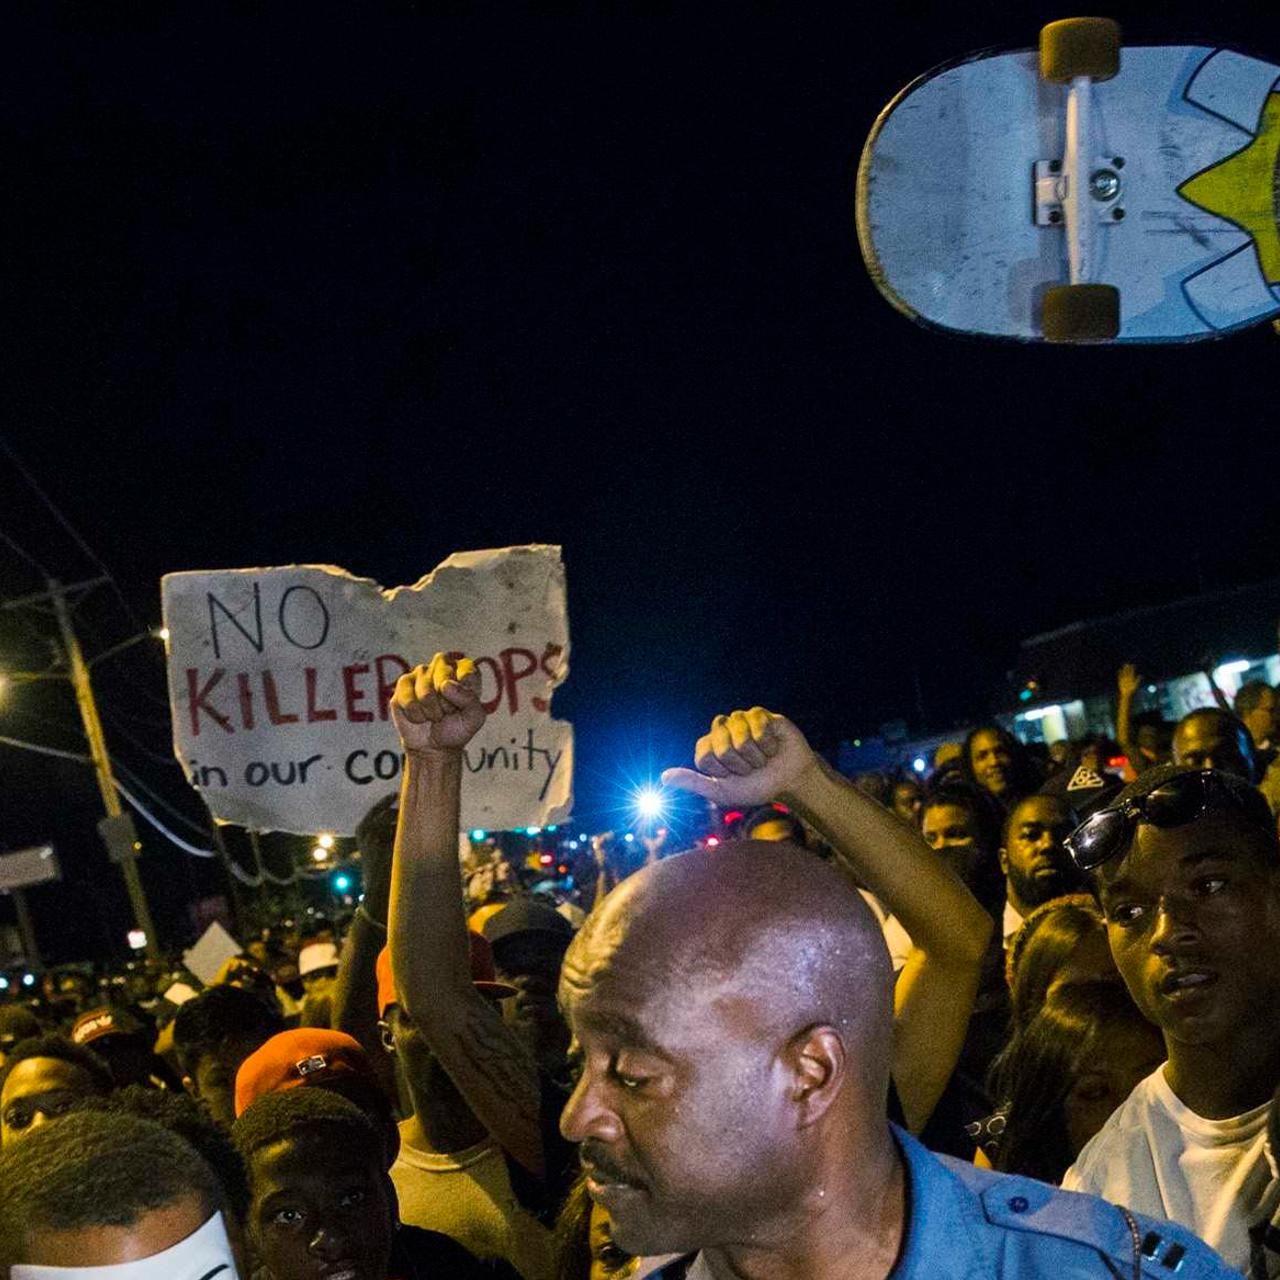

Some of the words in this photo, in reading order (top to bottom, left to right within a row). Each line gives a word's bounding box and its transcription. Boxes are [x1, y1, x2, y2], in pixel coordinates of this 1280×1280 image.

[207, 582, 329, 658] NO
[186, 653, 411, 736] KILLER
[190, 759, 228, 787] in
[244, 754, 322, 786] our
[345, 728, 563, 801] counity
